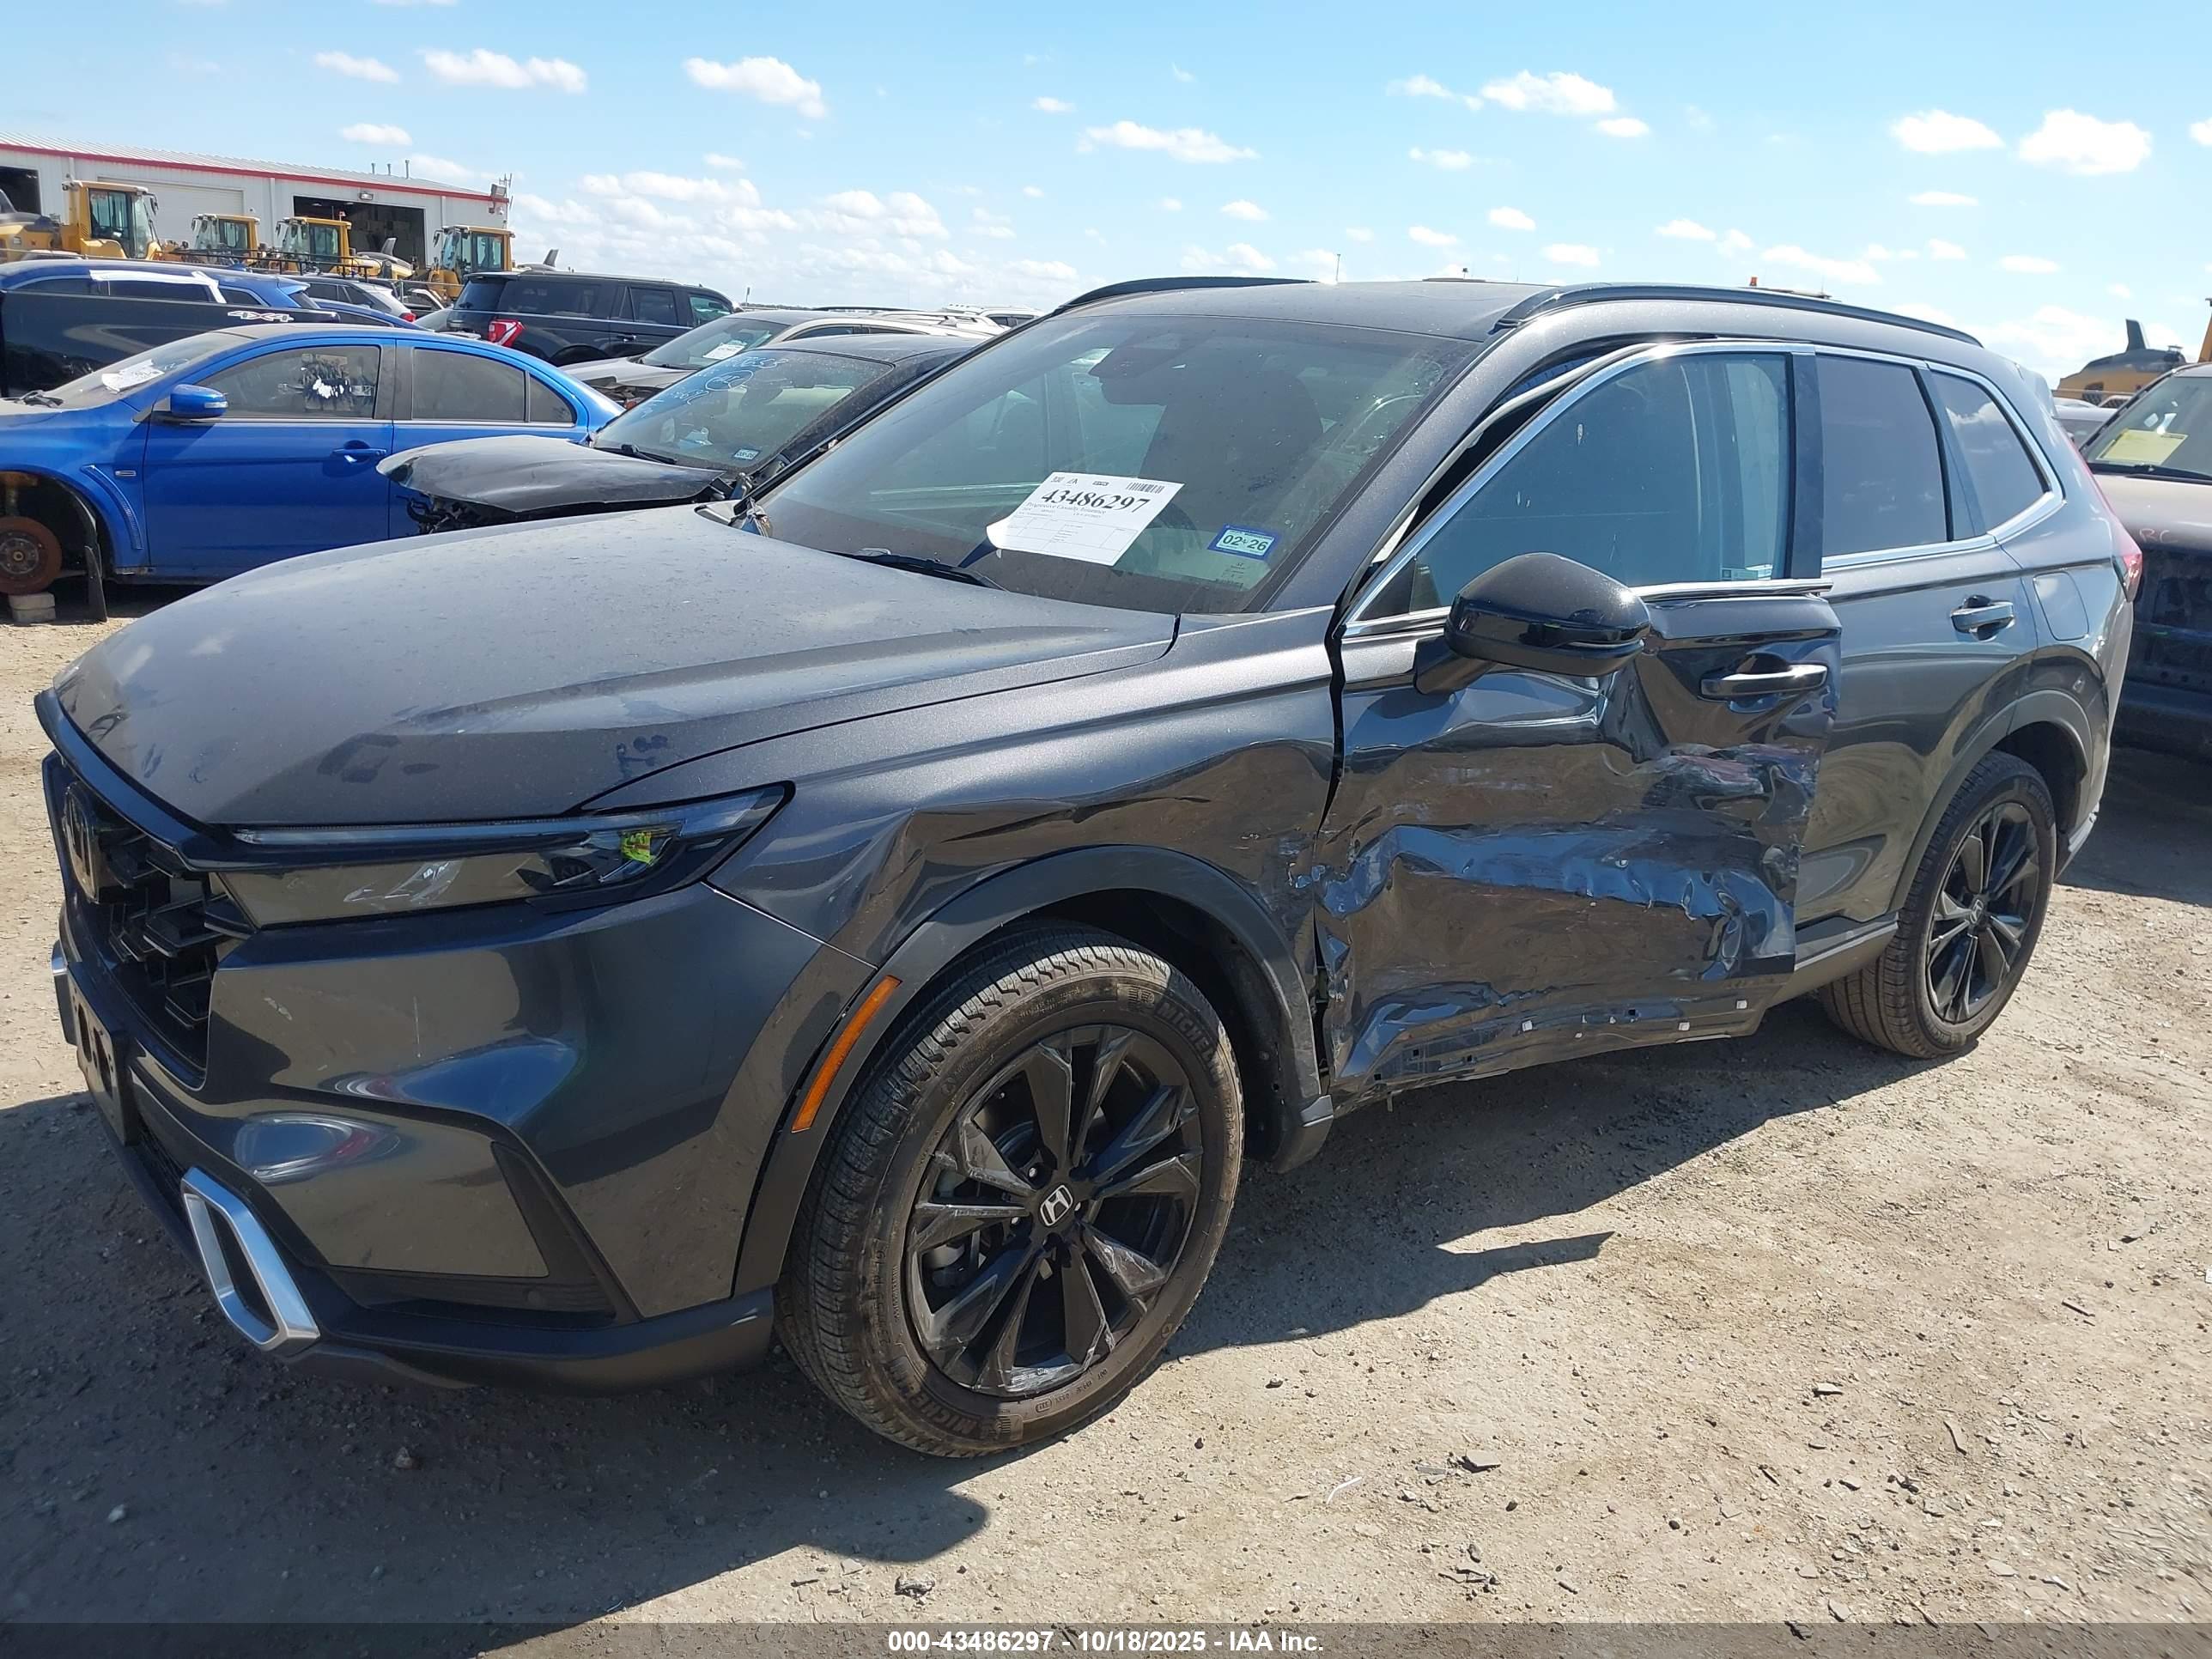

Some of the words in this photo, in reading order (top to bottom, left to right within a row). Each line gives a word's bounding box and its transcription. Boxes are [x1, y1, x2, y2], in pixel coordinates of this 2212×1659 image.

[1042, 489, 1151, 513] 43486297
[1223, 534, 1243, 546] 02
[1247, 538, 1268, 551] 26
